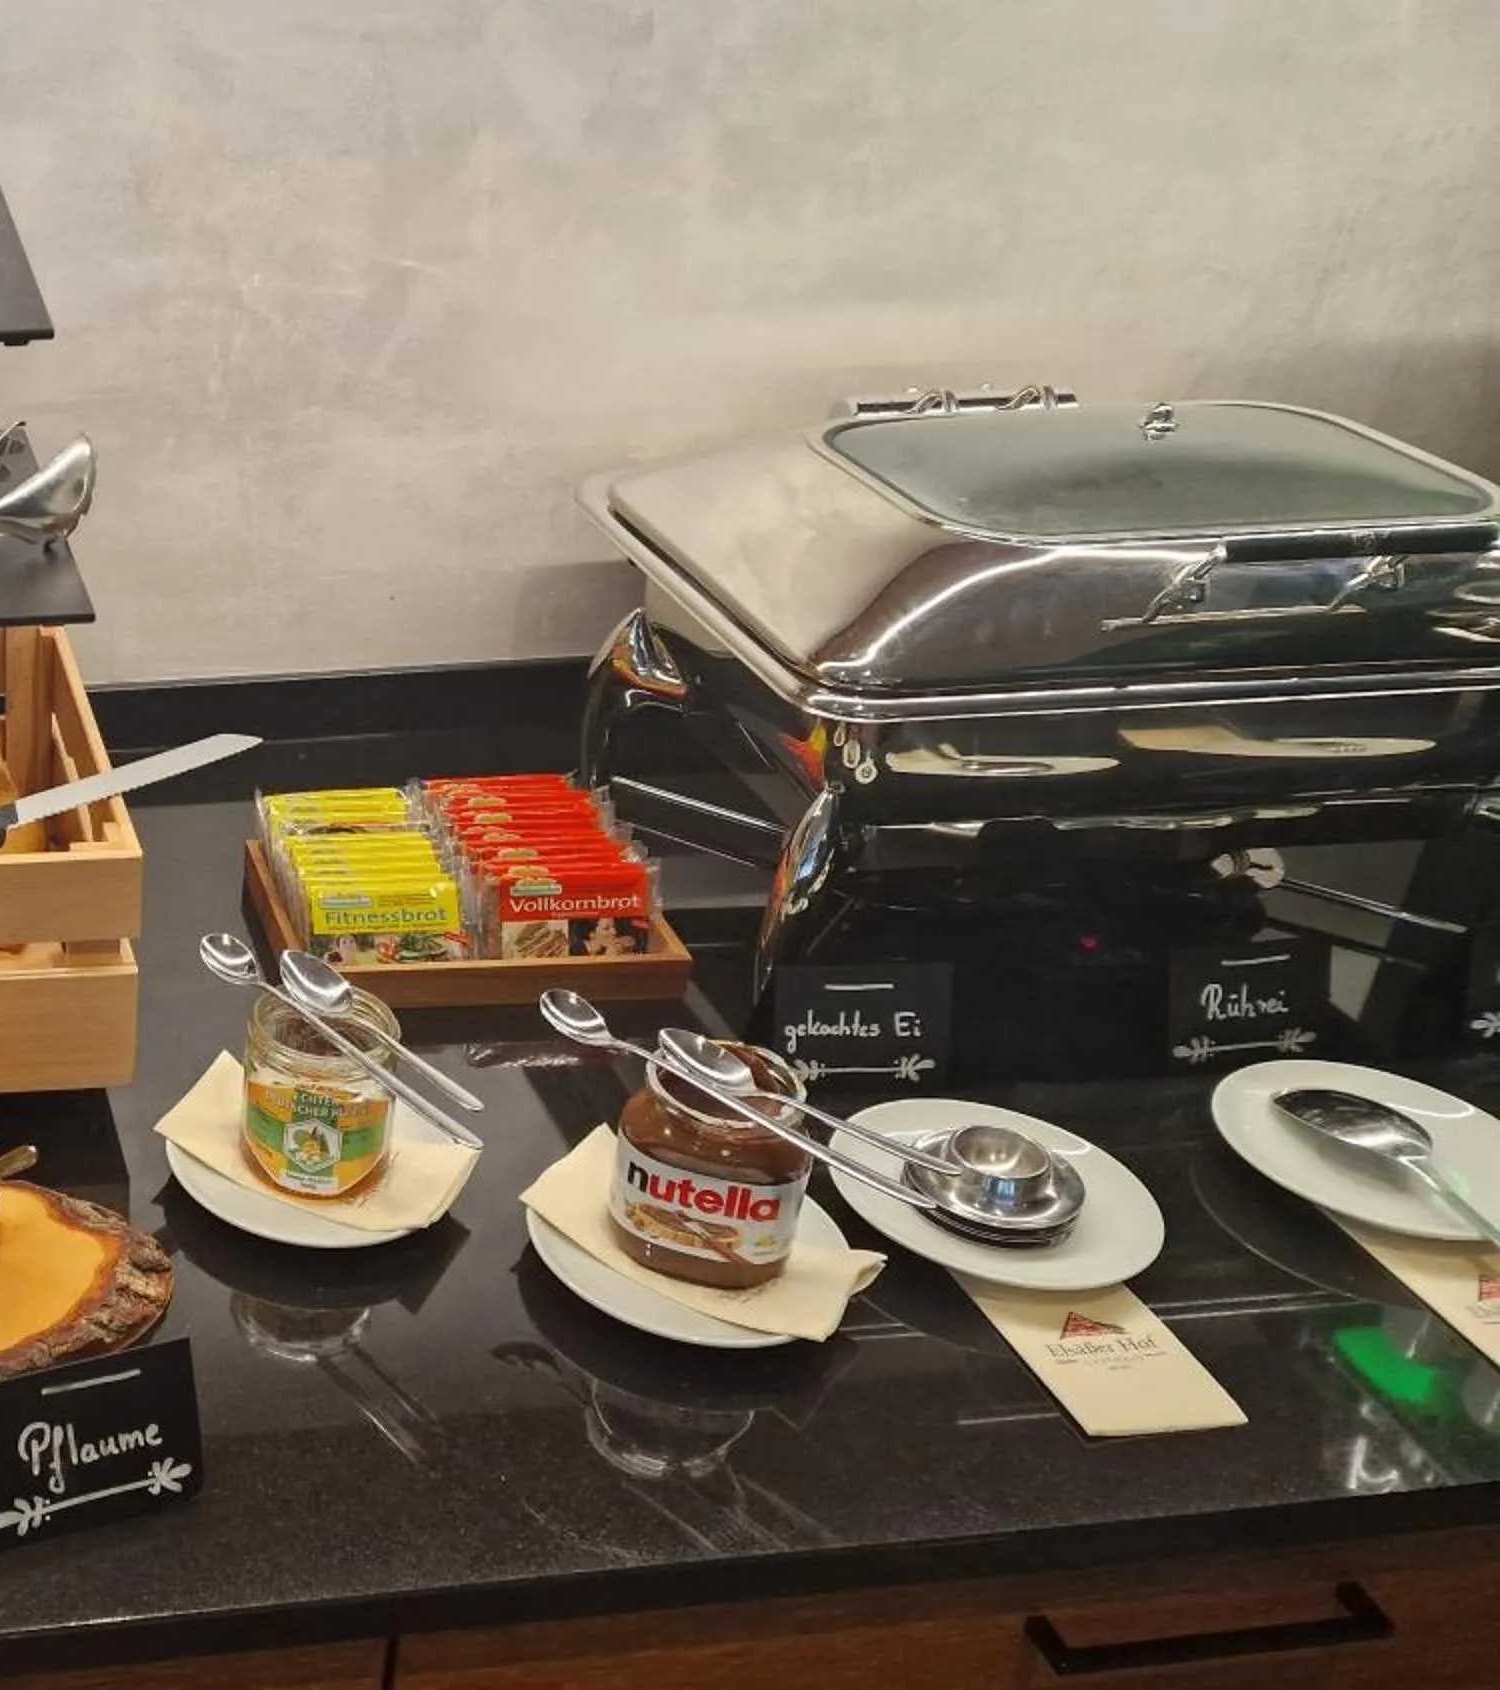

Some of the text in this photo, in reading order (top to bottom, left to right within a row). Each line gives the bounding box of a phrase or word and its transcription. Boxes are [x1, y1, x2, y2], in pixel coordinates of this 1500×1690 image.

[324, 908, 448, 926] Fitnessbrot
[509, 895, 640, 913] Vollkornbrot
[1200, 982, 1289, 1021] Rührei
[784, 1009, 922, 1054] gekochtes Ei
[626, 1158, 781, 1223] nutella
[1117, 1334, 1158, 1352] Hof
[17, 1421, 163, 1494] Pflaume
